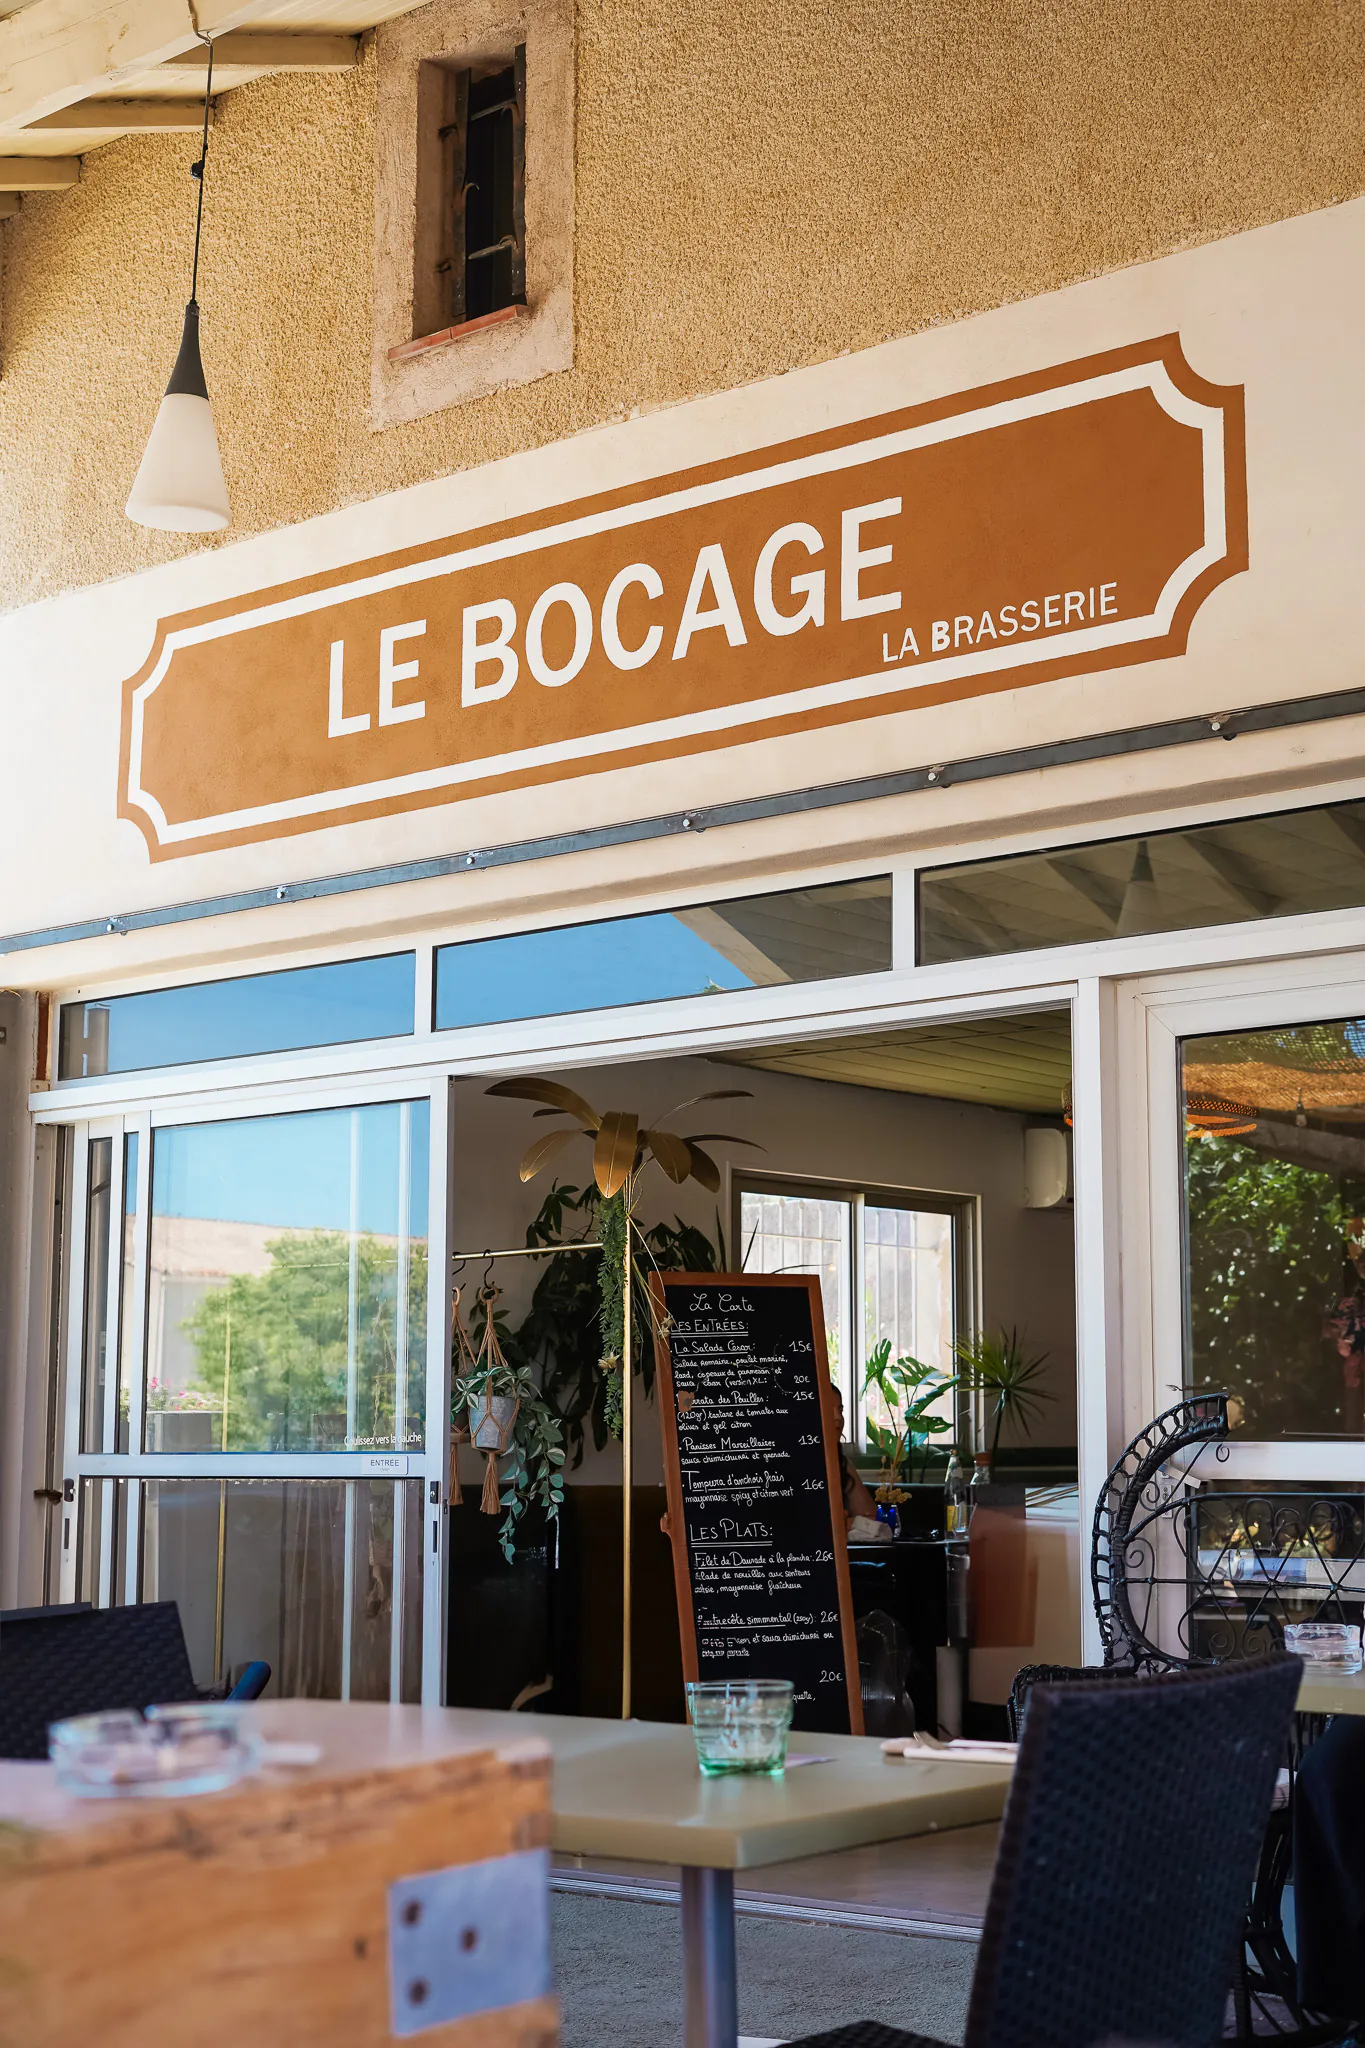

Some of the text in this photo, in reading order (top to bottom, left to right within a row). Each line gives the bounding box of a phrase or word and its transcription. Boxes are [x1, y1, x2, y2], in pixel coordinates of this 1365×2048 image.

[327, 496, 904, 739] LE BOCAGE
[882, 581, 1120, 664] LA BRASSERIE
[690, 1293, 755, 1312] La Carte
[674, 1342, 690, 1355] La
[692, 1341, 724, 1353] Salade
[789, 1341, 813, 1352] 15€
[673, 1358, 699, 1368] Salade
[774, 1367, 782, 1375] et
[794, 1375, 810, 1384] 20€
[718, 1393, 730, 1404] des
[792, 1391, 815, 1401] 15€
[736, 1408, 745, 1417] de
[747, 1407, 774, 1417] tomates
[678, 1421, 752, 1434] olives et gel citron
[375, 1436, 389, 1445] vers
[390, 1433, 397, 1444] la
[398, 1431, 422, 1446] gauche
[682, 1434, 821, 1451] Panisses Marseillaises 13€
[370, 1458, 399, 1467] ENTRÉE
[681, 1456, 701, 1465] sauce
[752, 1451, 760, 1460] et
[681, 1470, 726, 1494] Tempura
[764, 1470, 785, 1487] frais
[801, 1478, 825, 1490] 16€
[685, 1486, 795, 1509] mayonnaise spicy et citron vert
[690, 1518, 773, 1541] LES PLATS:
[694, 1552, 719, 1567] Filet
[720, 1554, 731, 1566] de
[729, 1551, 767, 1566] Daurade
[769, 1553, 775, 1563] à
[776, 1552, 785, 1563] la
[815, 1549, 834, 1562] 26€
[722, 1571, 731, 1579] de
[734, 1569, 765, 1579] nouilles
[768, 1570, 783, 1578] aux
[719, 1582, 764, 1597] mayonnaise
[697, 1610, 746, 1626] trecôte
[747, 1612, 792, 1624] simmental
[820, 1610, 838, 1623] 26€
[752, 1633, 760, 1643] et
[761, 1634, 783, 1643] sauce
[819, 1669, 843, 1683] 20€
